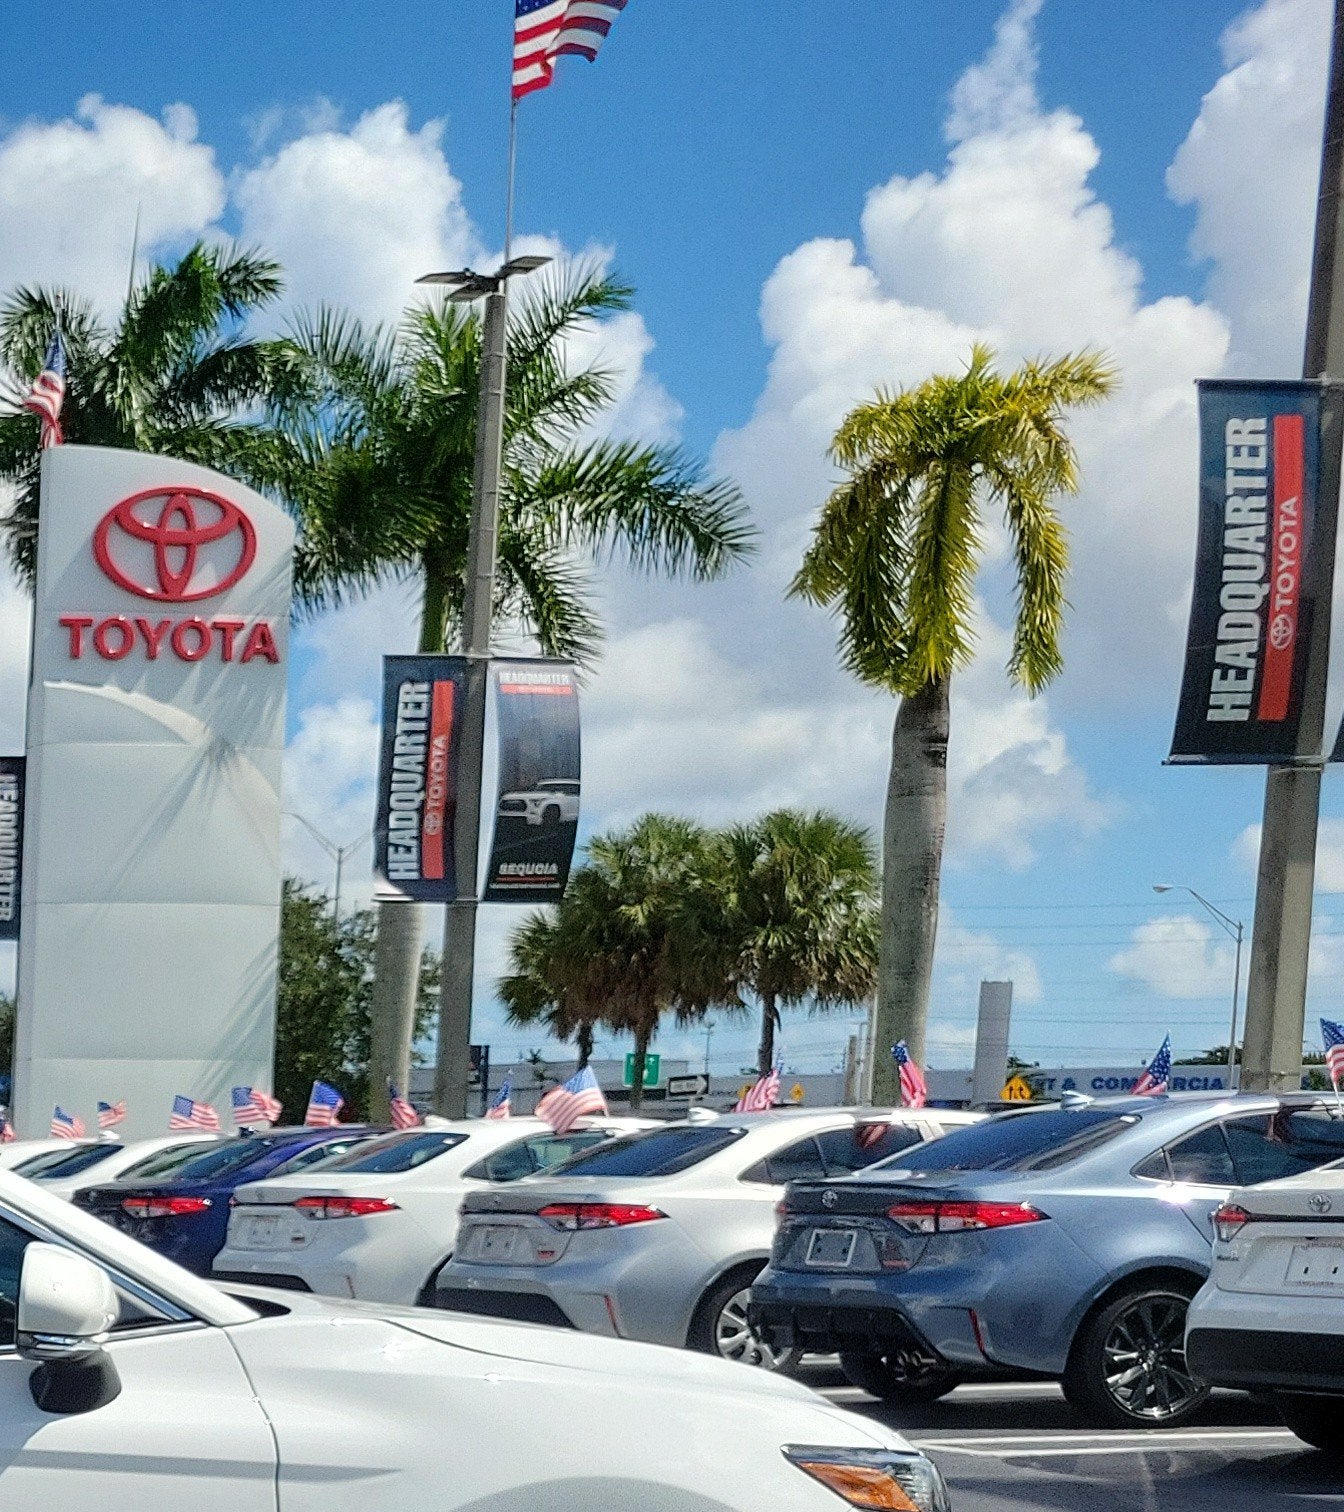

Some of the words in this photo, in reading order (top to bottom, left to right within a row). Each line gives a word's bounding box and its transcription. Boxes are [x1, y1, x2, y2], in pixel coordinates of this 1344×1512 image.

[1206, 417, 1270, 722] HEADQUARTER
[1275, 496, 1299, 612] TOYOTA
[59, 617, 280, 664] TOYOTA
[388, 681, 431, 880] HEADQUARTER
[427, 735, 448, 811] TOYOTA
